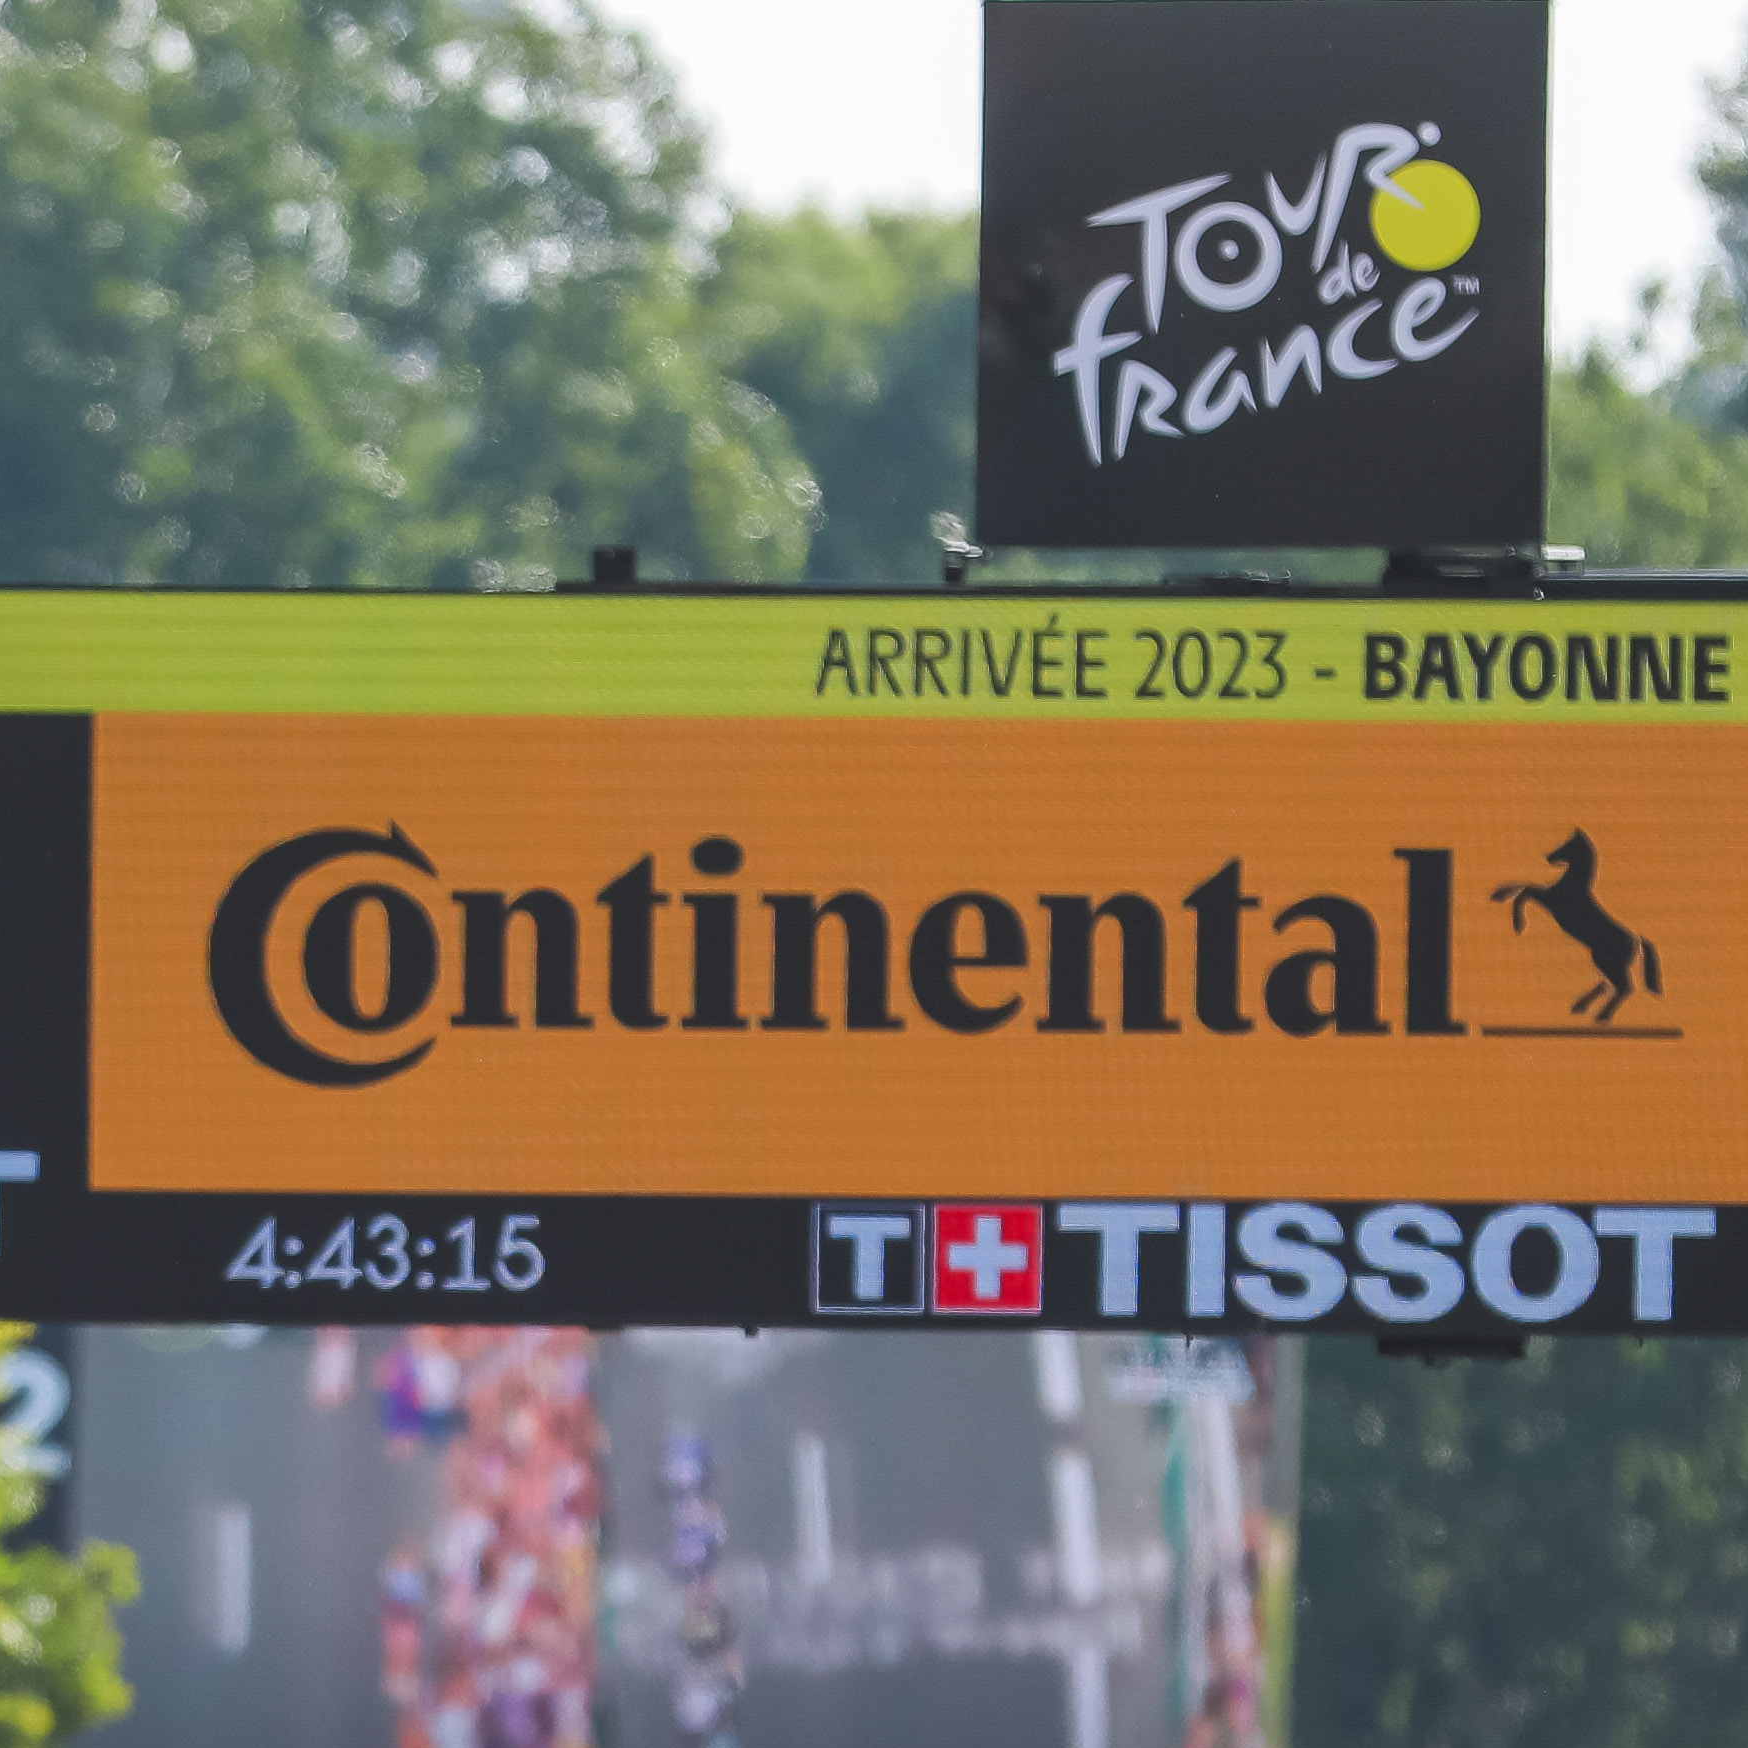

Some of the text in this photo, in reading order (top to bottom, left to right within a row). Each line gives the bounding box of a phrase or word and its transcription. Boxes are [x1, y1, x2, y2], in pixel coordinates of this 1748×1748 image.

[1319, 241, 1380, 305] de
[815, 614, 1108, 698] ARRIVÉE
[1133, 628, 1288, 700] 2023
[1362, 632, 1732, 704] BAYONNE
[208, 820, 1467, 1087] Continental
[225, 1214, 545, 1292] 4:43:15
[1058, 1203, 1716, 1322] TISSOT
